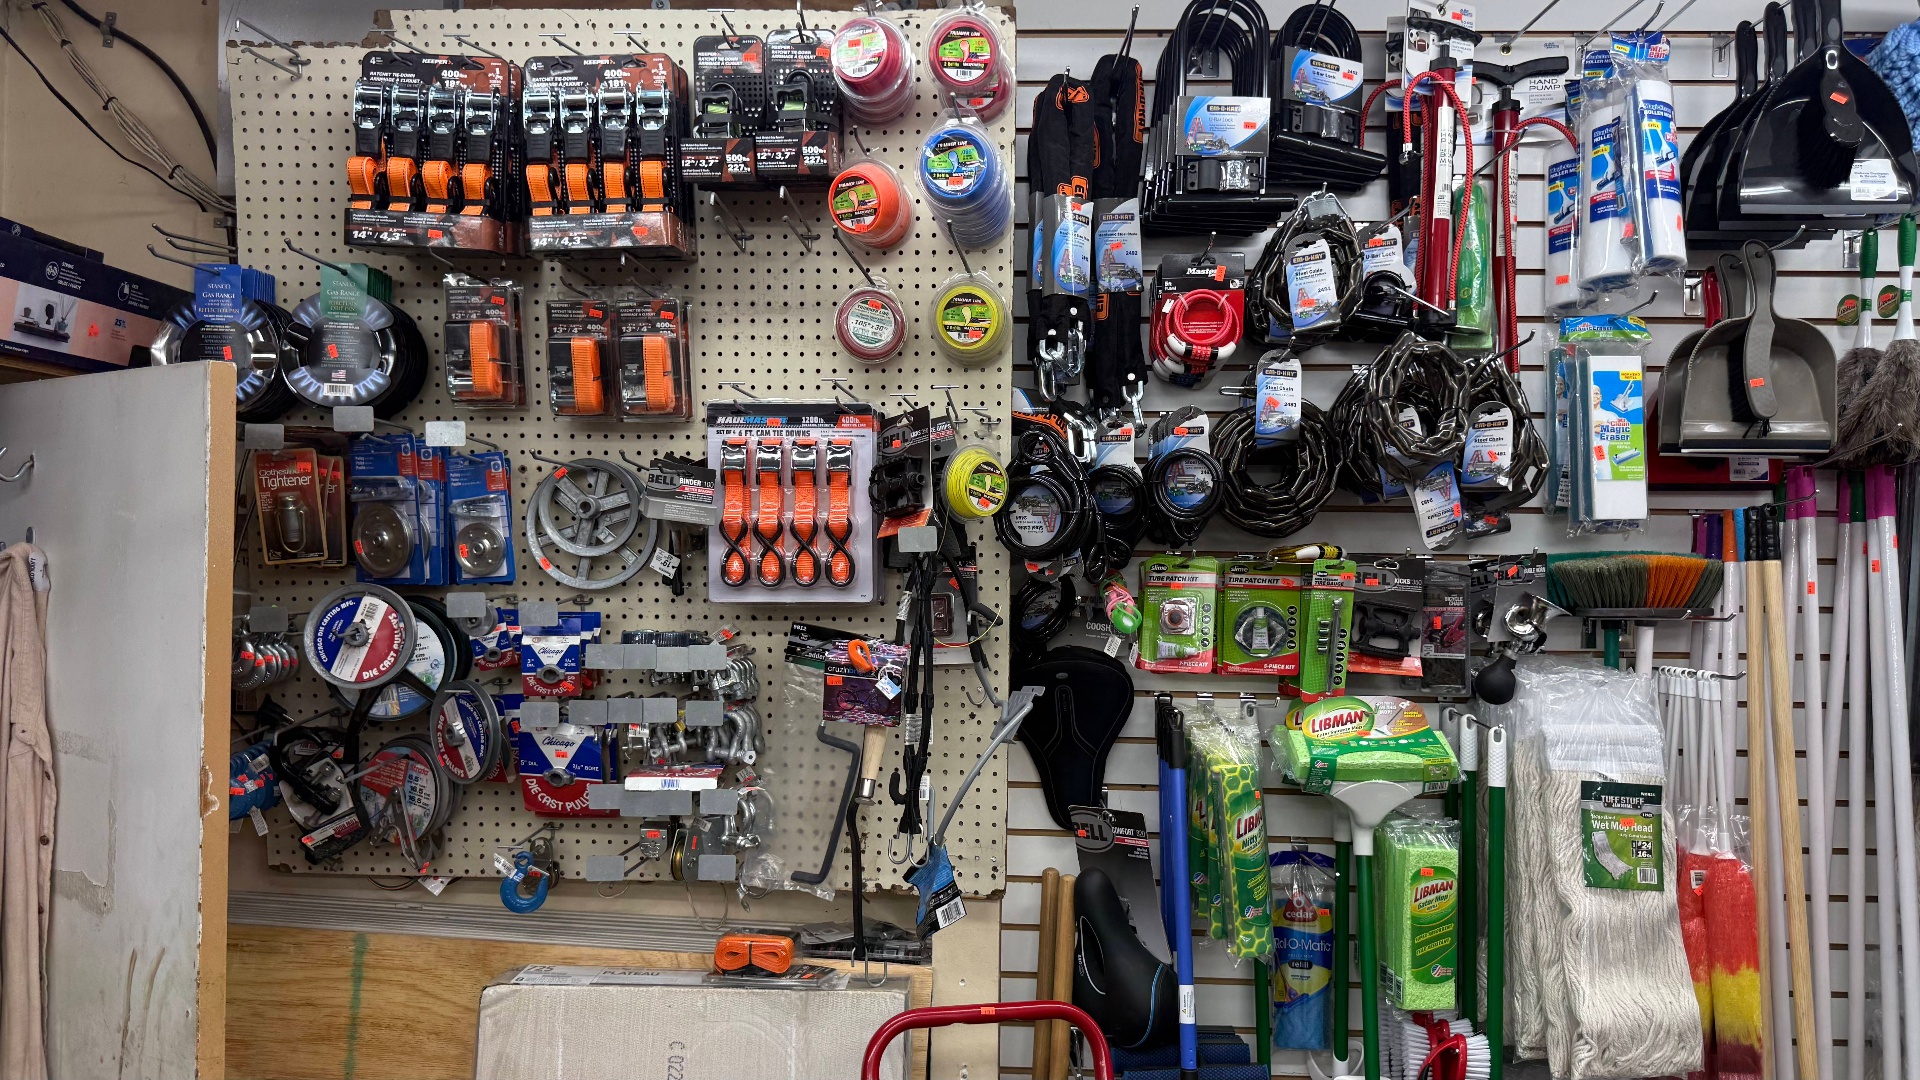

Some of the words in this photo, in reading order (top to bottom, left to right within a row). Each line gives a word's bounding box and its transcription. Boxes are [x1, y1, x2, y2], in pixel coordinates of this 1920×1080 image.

[1600, 425, 1630, 434] Magic
[882, 430, 908, 449] BELL
[259, 475, 311, 490] Tightener
[648, 473, 677, 487] BELL
[680, 477, 702, 487] BINDER
[316, 637, 328, 662] CHICAGO
[322, 606, 340, 626] CASTING
[341, 600, 356, 610] MFG.
[388, 612, 401, 649] PULLEYS
[538, 647, 564, 655] Chicago
[380, 651, 397, 671] CAST
[362, 668, 379, 679] DIE
[534, 685, 550, 694] CAST
[1311, 710, 1364, 733] LIBMAN
[542, 736, 576, 748] Chicago
[443, 754, 464, 778] PULLEYS
[526, 778, 537, 795] DIE
[537, 794, 563, 811] CAST
[1601, 795, 1619, 803] TUFF
[1621, 796, 1645, 805] STUFF
[1592, 820, 1609, 830] Wet
[1611, 821, 1629, 832] Mop
[1631, 824, 1653, 832] Head
[1242, 834, 1258, 849] Nitty
[1414, 880, 1454, 903] LIBMAN
[1418, 898, 1434, 910] Gator
[1435, 894, 1449, 903] Mop
[1286, 910, 1313, 919] cedar
[1274, 938, 1331, 951] Rol-O-Matic
[1291, 961, 1309, 969] refill
